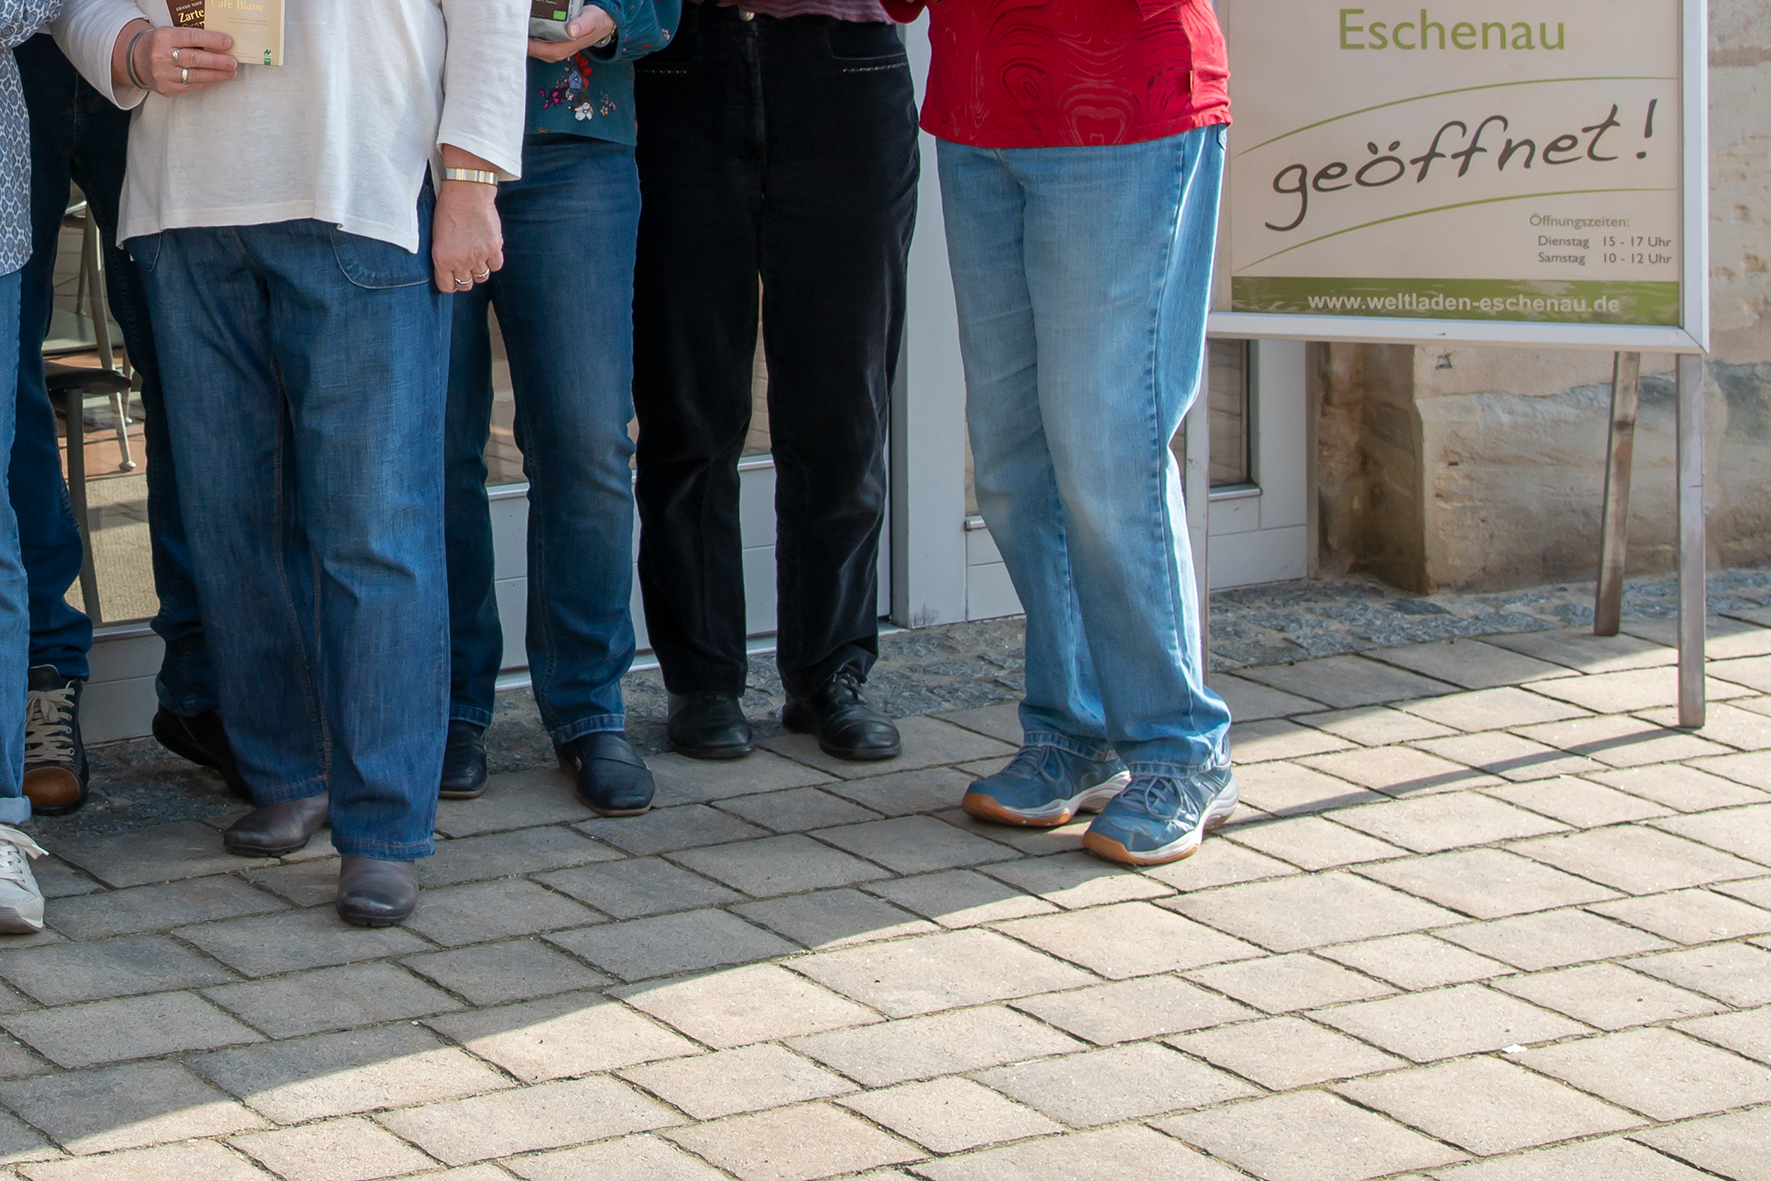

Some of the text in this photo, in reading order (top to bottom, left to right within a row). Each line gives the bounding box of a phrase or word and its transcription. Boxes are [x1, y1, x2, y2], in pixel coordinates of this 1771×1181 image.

[236, 0, 265, 12] Blanc
[178, 9, 205, 23] Zarte
[1339, 8, 1566, 51] Eschenau
[1264, 98, 1658, 232] geöffnet!
[1529, 212, 1630, 230] Öffnungszeiten:
[1537, 235, 1589, 249] Dienstag
[1603, 236, 1616, 247] 15
[1630, 236, 1643, 247] 17
[1647, 236, 1672, 247] Uhr
[1537, 251, 1586, 266] Samstag
[1603, 253, 1617, 264] 10
[1631, 253, 1644, 264] 12
[1647, 253, 1672, 264] Uhr
[1307, 293, 1621, 313] www.weltladen-eschenau.de
